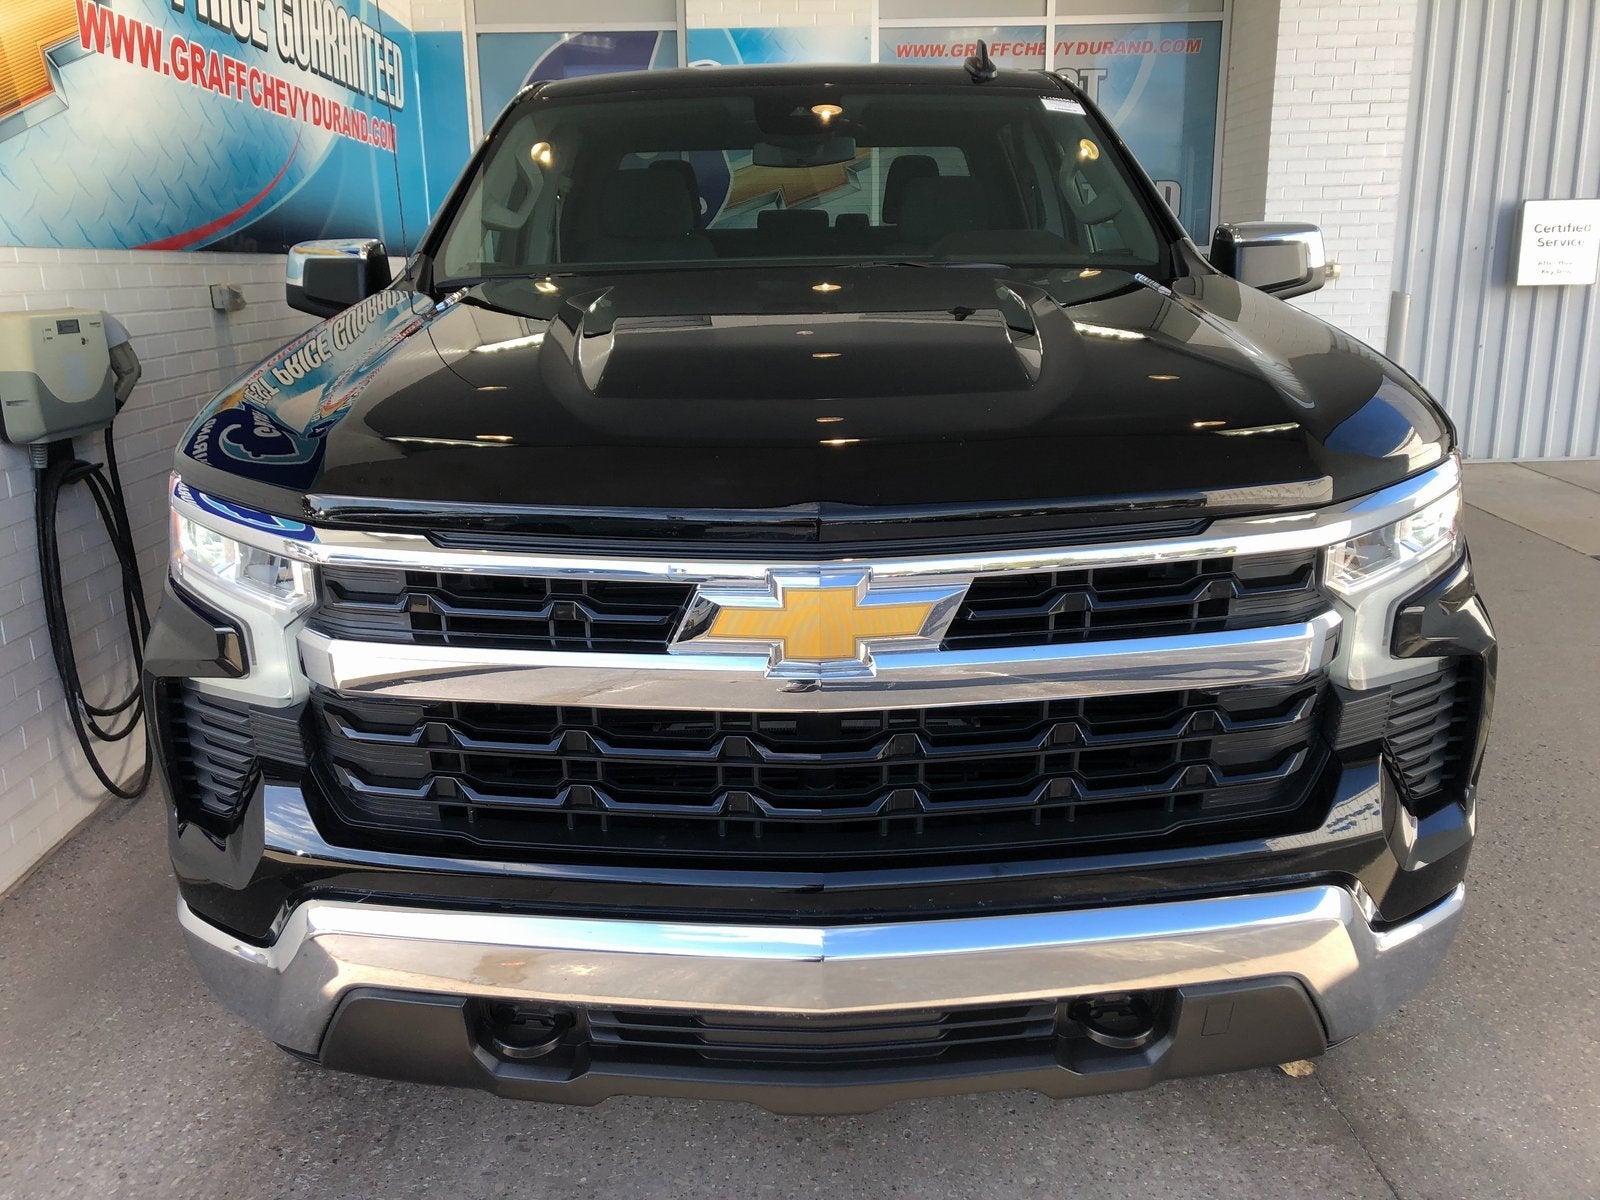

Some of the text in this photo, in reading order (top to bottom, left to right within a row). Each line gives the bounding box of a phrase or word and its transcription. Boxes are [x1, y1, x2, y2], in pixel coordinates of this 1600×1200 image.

[77, 0, 397, 153] WWW.GRAFFCHEVYDURAND.COM
[276, 0, 404, 111] GUARANTEED
[896, 39, 1202, 58] WWW.GRFFCHEVYDURAND.COM
[1534, 223, 1592, 234] Certified
